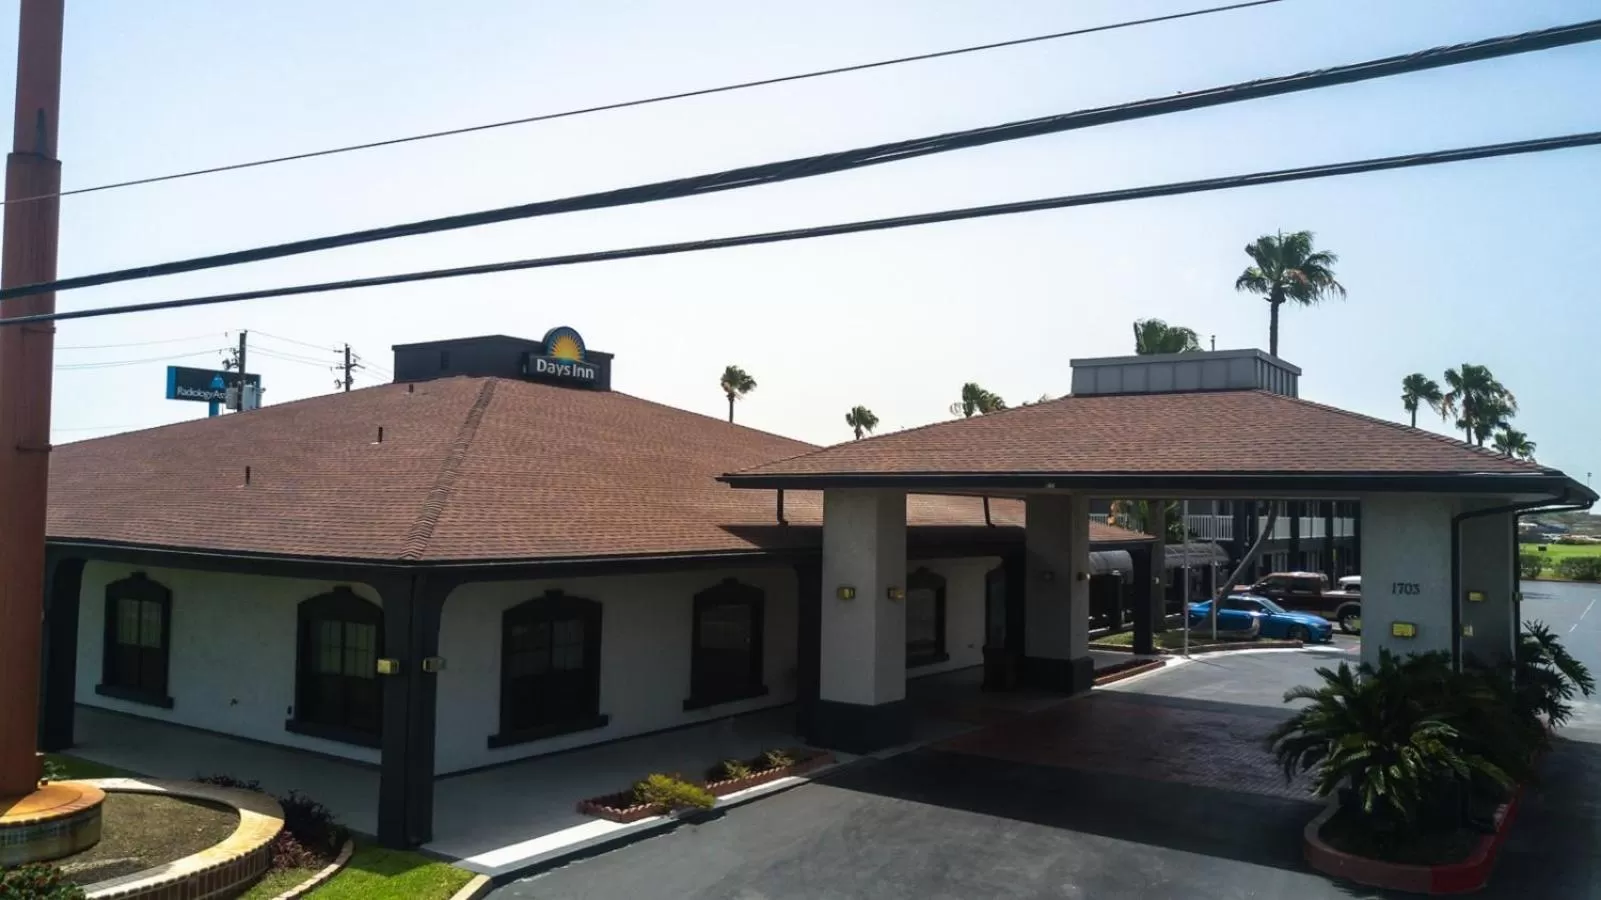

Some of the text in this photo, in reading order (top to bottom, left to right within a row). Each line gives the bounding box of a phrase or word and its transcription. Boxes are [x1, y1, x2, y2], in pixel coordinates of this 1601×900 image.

[536, 358, 595, 379] Days Inn
[177, 386, 212, 399] Radiology
[1391, 582, 1421, 595] 1703
